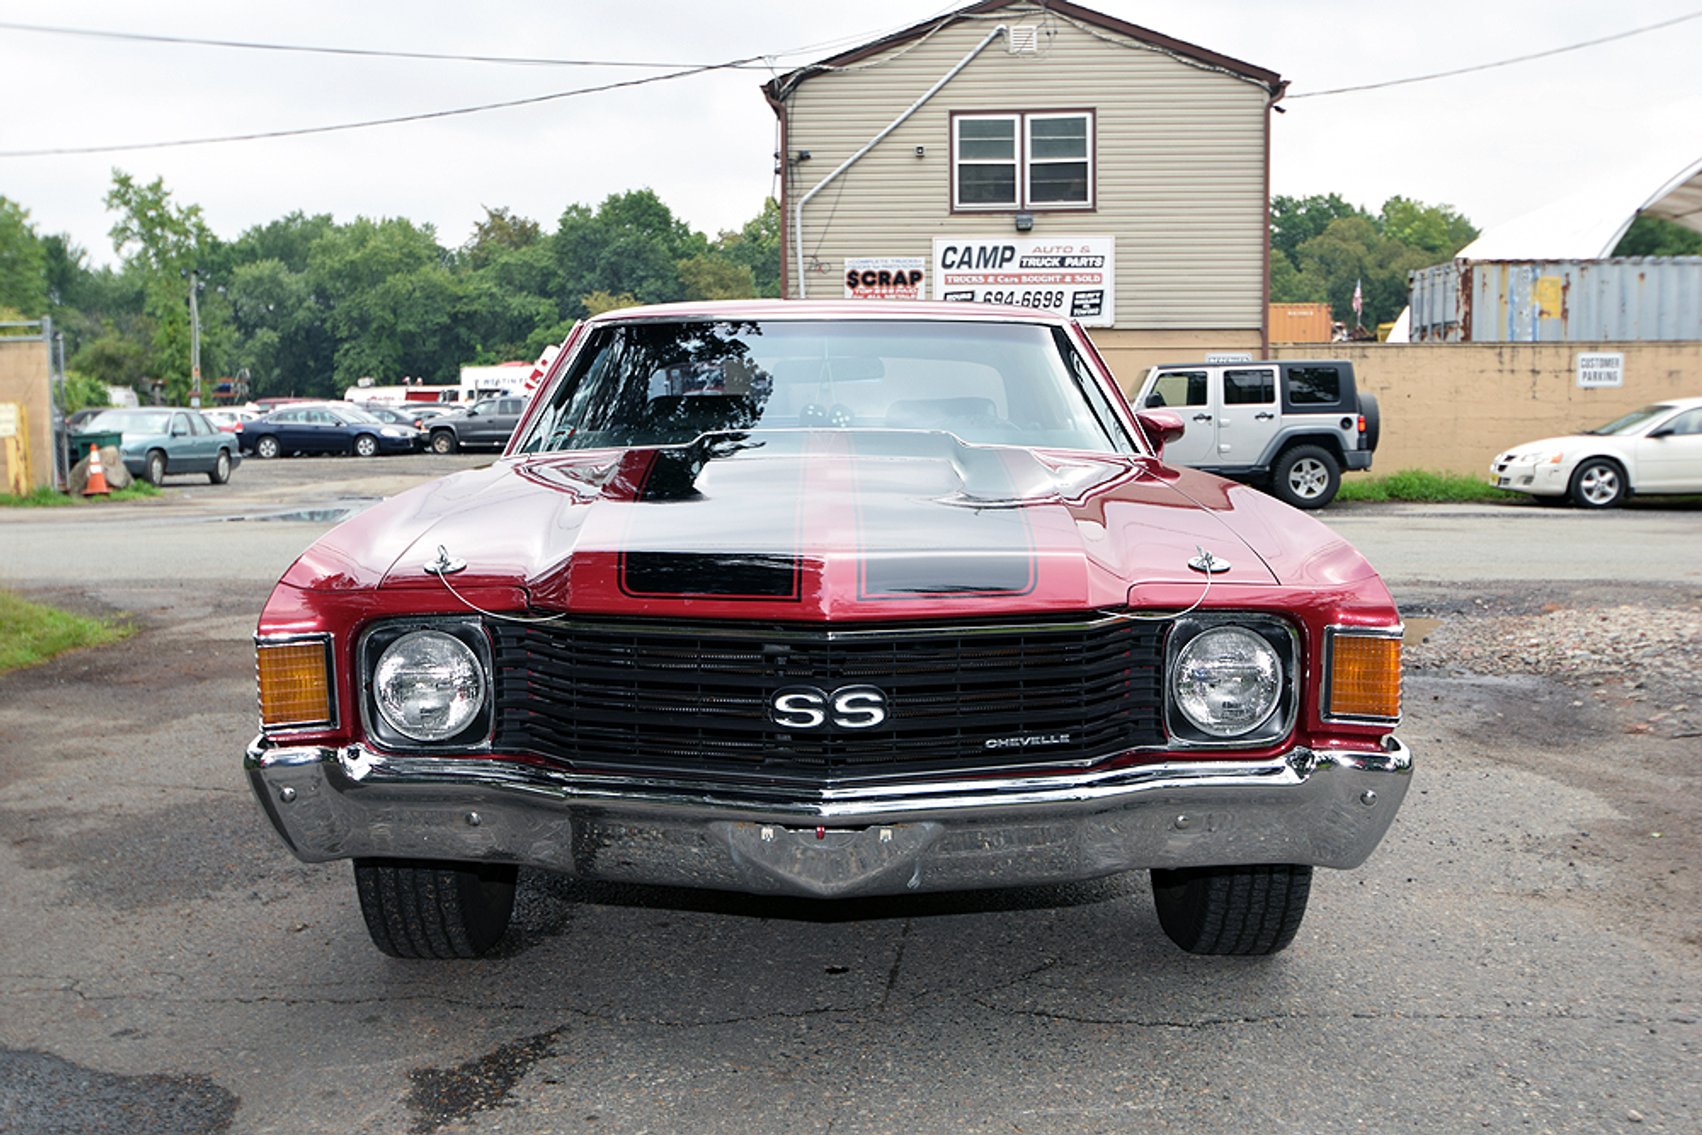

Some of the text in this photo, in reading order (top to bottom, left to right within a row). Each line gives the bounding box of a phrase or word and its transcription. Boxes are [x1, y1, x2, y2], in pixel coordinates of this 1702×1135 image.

[1032, 245, 1091, 254] AUTO &
[941, 245, 1016, 270] CAMP
[1021, 257, 1103, 267] TRUCK PARTS
[946, 275, 985, 283] TRUCKS
[983, 290, 1065, 309] 694-6698
[1580, 357, 1620, 369] CUSTOMER
[1582, 370, 1618, 382] PARKING
[773, 692, 886, 729] SS
[985, 734, 1070, 749] CHEVELLE
